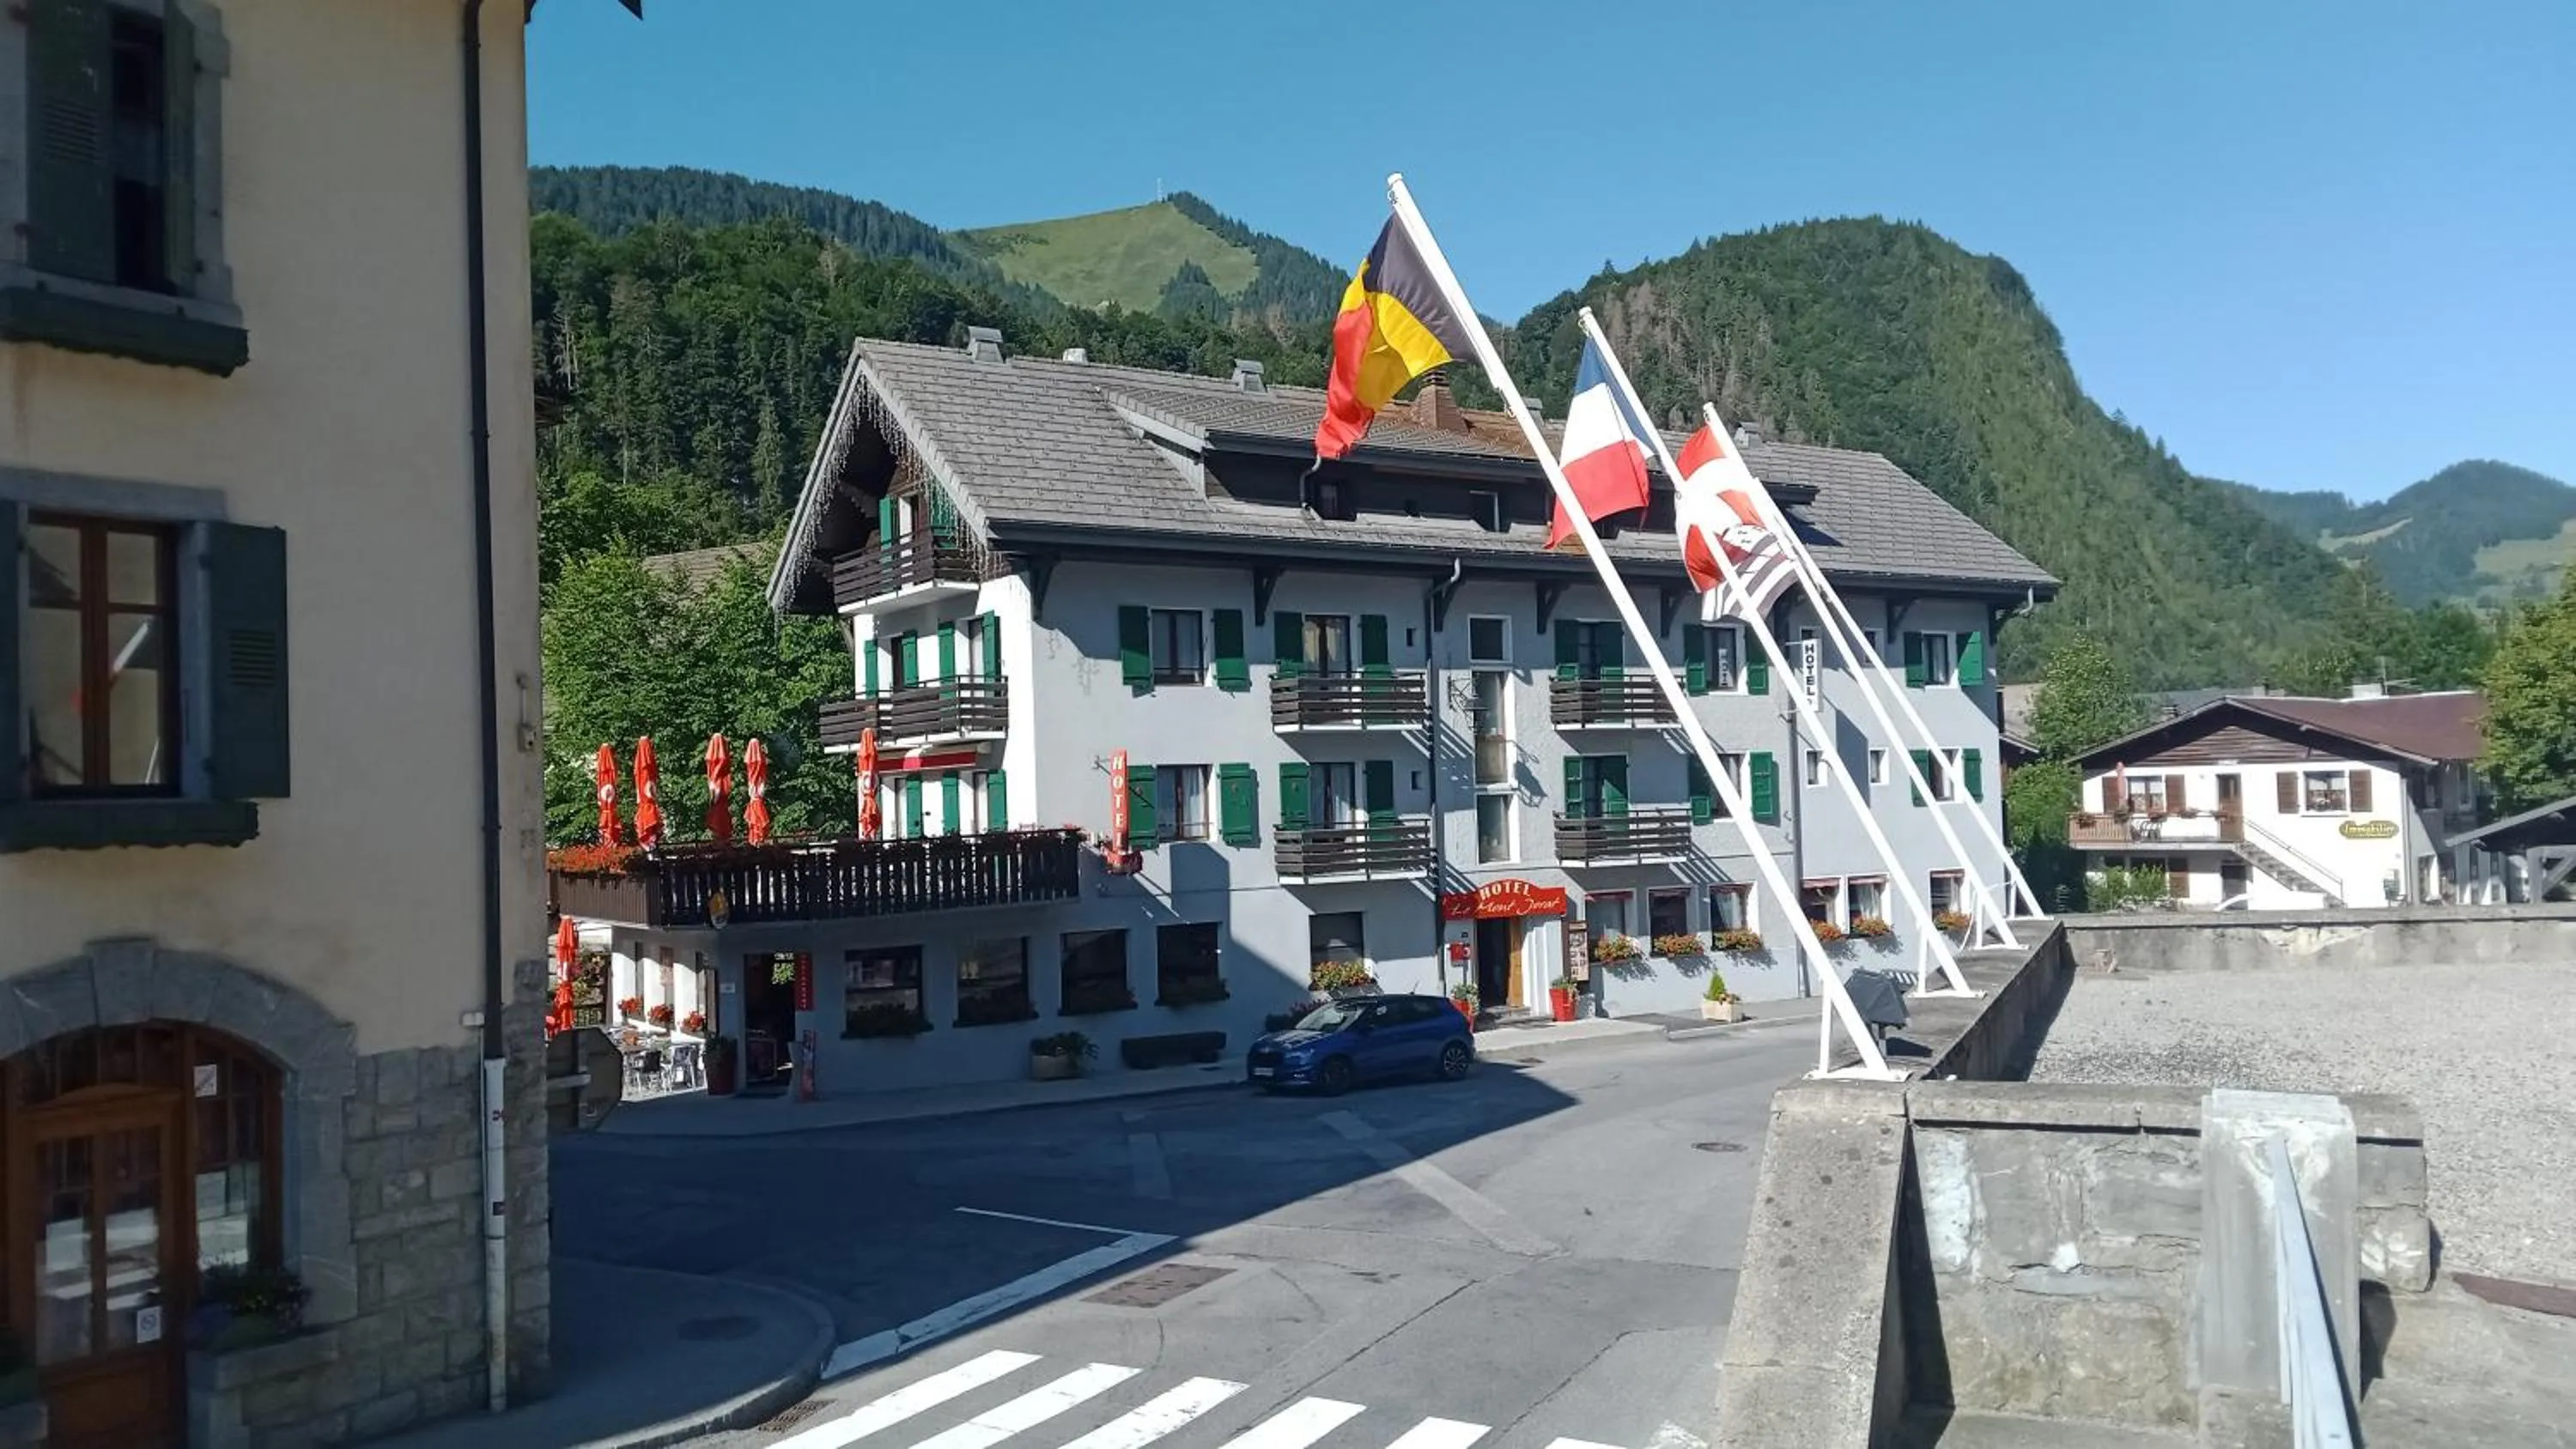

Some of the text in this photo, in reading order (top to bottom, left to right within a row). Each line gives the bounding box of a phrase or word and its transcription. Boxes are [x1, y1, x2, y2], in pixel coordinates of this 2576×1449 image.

[1805, 643, 1815, 696] HOTEL
[1112, 755, 1126, 847] HOTEL
[1479, 882, 1530, 900] HOTEL
